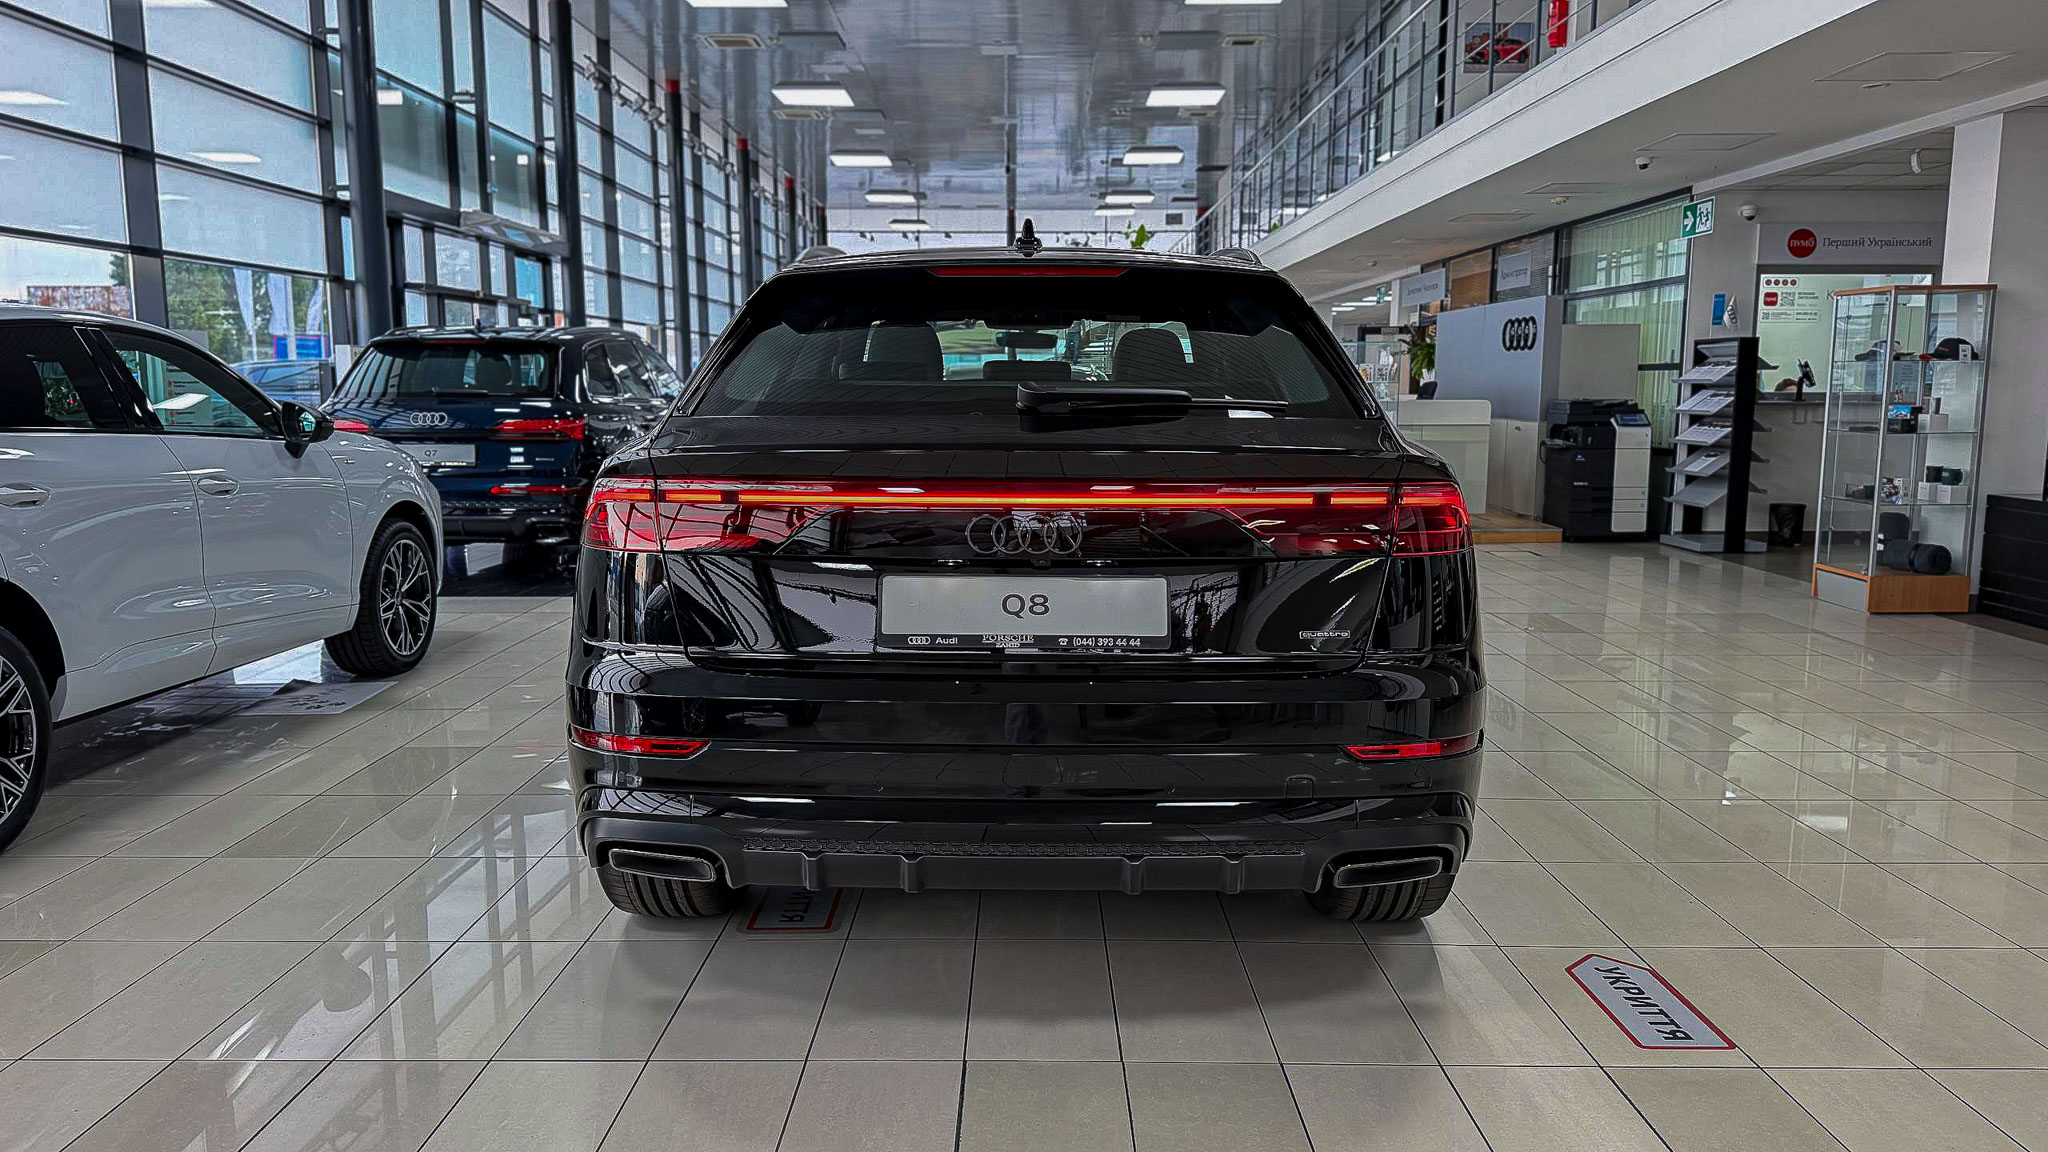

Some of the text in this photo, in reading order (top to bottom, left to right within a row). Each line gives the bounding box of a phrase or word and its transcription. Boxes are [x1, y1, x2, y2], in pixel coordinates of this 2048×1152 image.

[1823, 237, 1933, 249] Перший Український
[424, 449, 438, 457] Q7
[1001, 593, 1050, 619] Q8
[935, 636, 958, 645] Audi
[982, 634, 1035, 642] PORSCHE
[1073, 636, 1141, 647] (044) 393 44 44
[1594, 966, 1695, 1041] УКРИТТЯ
